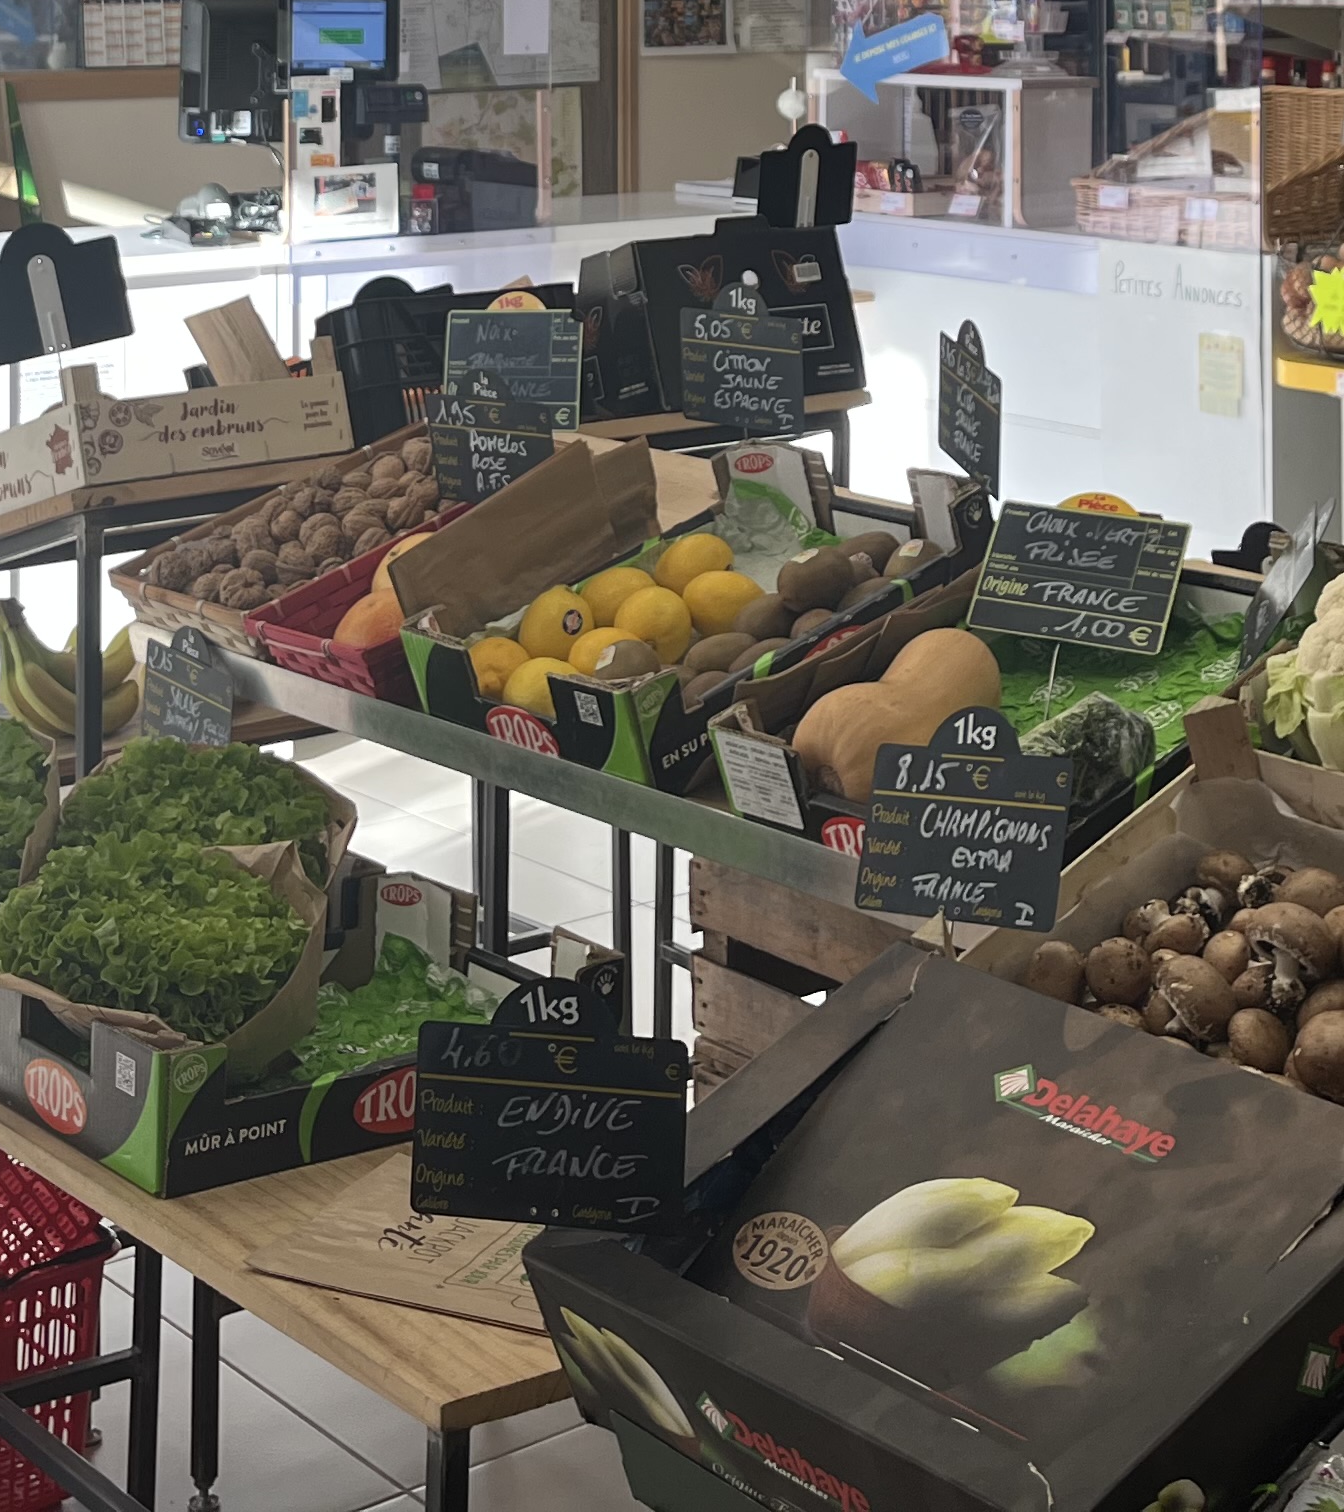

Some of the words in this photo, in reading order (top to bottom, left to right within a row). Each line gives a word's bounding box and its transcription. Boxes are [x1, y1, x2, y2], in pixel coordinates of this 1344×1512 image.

[1114, 259, 1163, 299] PETITES
[729, 288, 757, 315] 1kg
[720, 374, 783, 390] JAUNE
[180, 398, 238, 421] Jardin
[713, 390, 792, 414] ESPAGNE
[157, 425, 188, 444] des
[192, 419, 264, 438] embruns
[735, 453, 773, 473] TROPS
[1078, 498, 1119, 512] Pièce
[982, 575, 1029, 597] Origine
[1033, 581, 1148, 613] FRANCE
[1128, 626, 1153, 647] €
[489, 715, 557, 755] TROPS
[954, 713, 997, 750] 1kg
[662, 748, 681, 769] EN
[681, 738, 699, 759] SU
[972, 765, 992, 790] €
[872, 803, 910, 826] Produit
[825, 823, 866, 859] TRO
[383, 886, 422, 904] TROPS
[861, 868, 897, 893] Origine
[912, 873, 997, 904] FRANCE
[520, 985, 580, 1025] 1kg
[555, 1046, 578, 1075] €
[26, 1064, 86, 1131] TROPS
[359, 1069, 417, 1127] TRO
[419, 1089, 475, 1116] Produit
[1023, 1077, 1176, 1158] Delahaye
[184, 1130, 222, 1157] MÛR
[223, 1125, 236, 1149] À
[238, 1118, 288, 1144] POINT
[415, 1164, 465, 1192] Origine
[492, 1145, 649, 1181] FRANCE
[378, 1213, 435, 1251] anté
[407, 1217, 481, 1265] JACKPOT
[751, 1215, 824, 1262] MARAÎCHER
[740, 1233, 811, 1282] 1920
[725, 1409, 871, 1512] Delahaye
